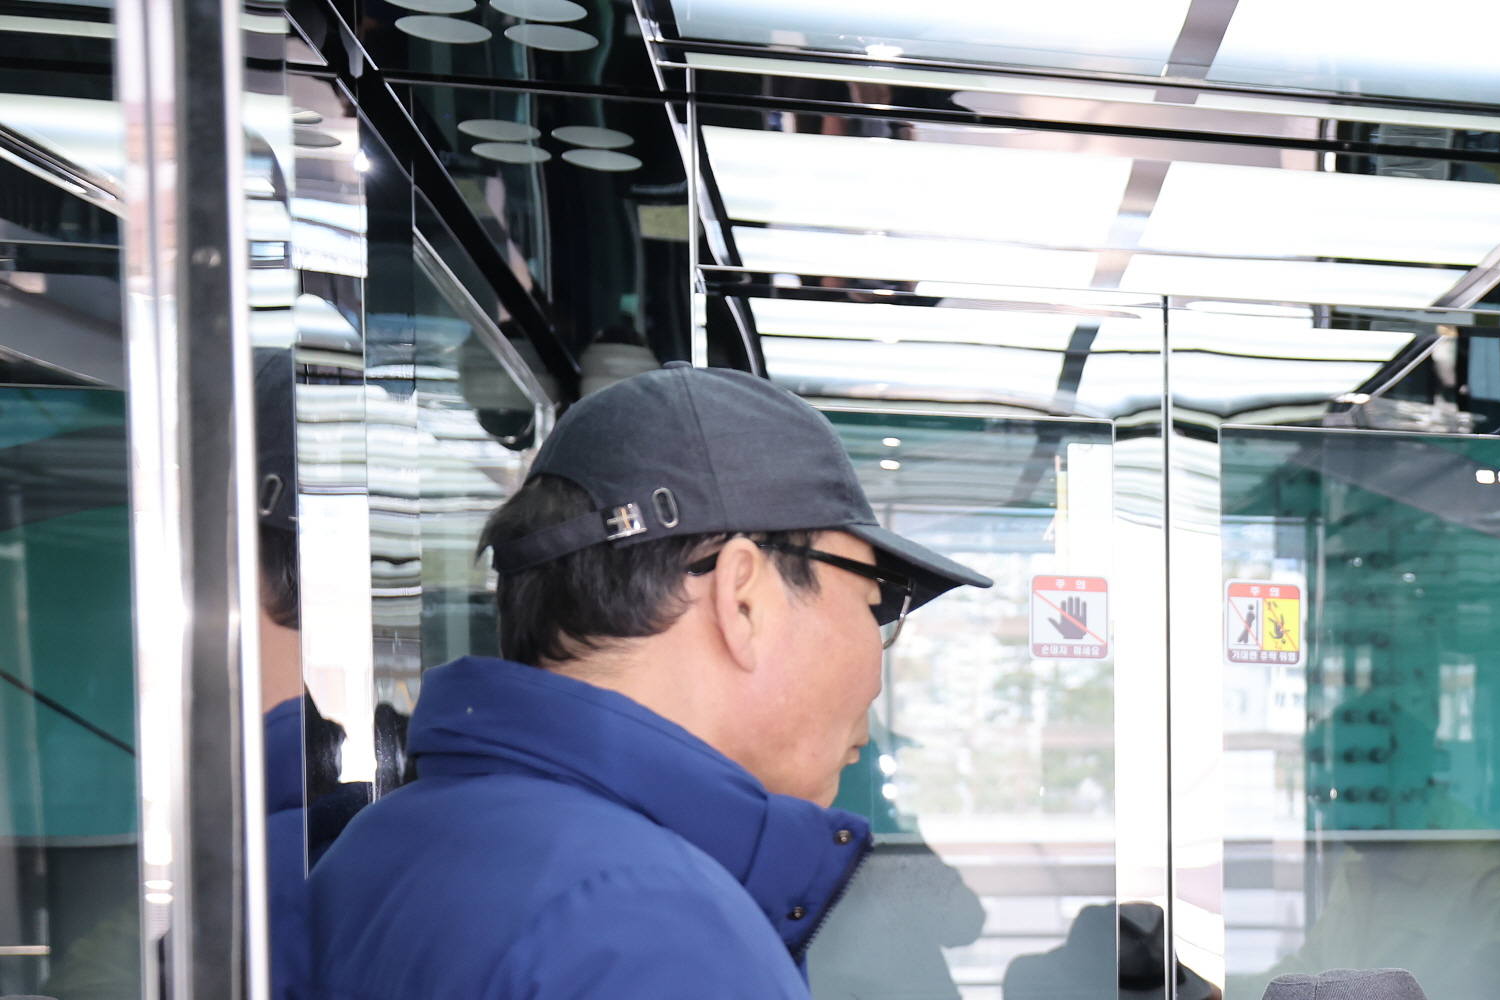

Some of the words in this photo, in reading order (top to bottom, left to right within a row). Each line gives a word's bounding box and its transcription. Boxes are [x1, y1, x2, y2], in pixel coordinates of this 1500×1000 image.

[1041, 644, 1067, 656] 손대지
[1073, 645, 1100, 656] 마세요
[1260, 651, 1277, 661] 추락
[1279, 651, 1297, 661] 위험
